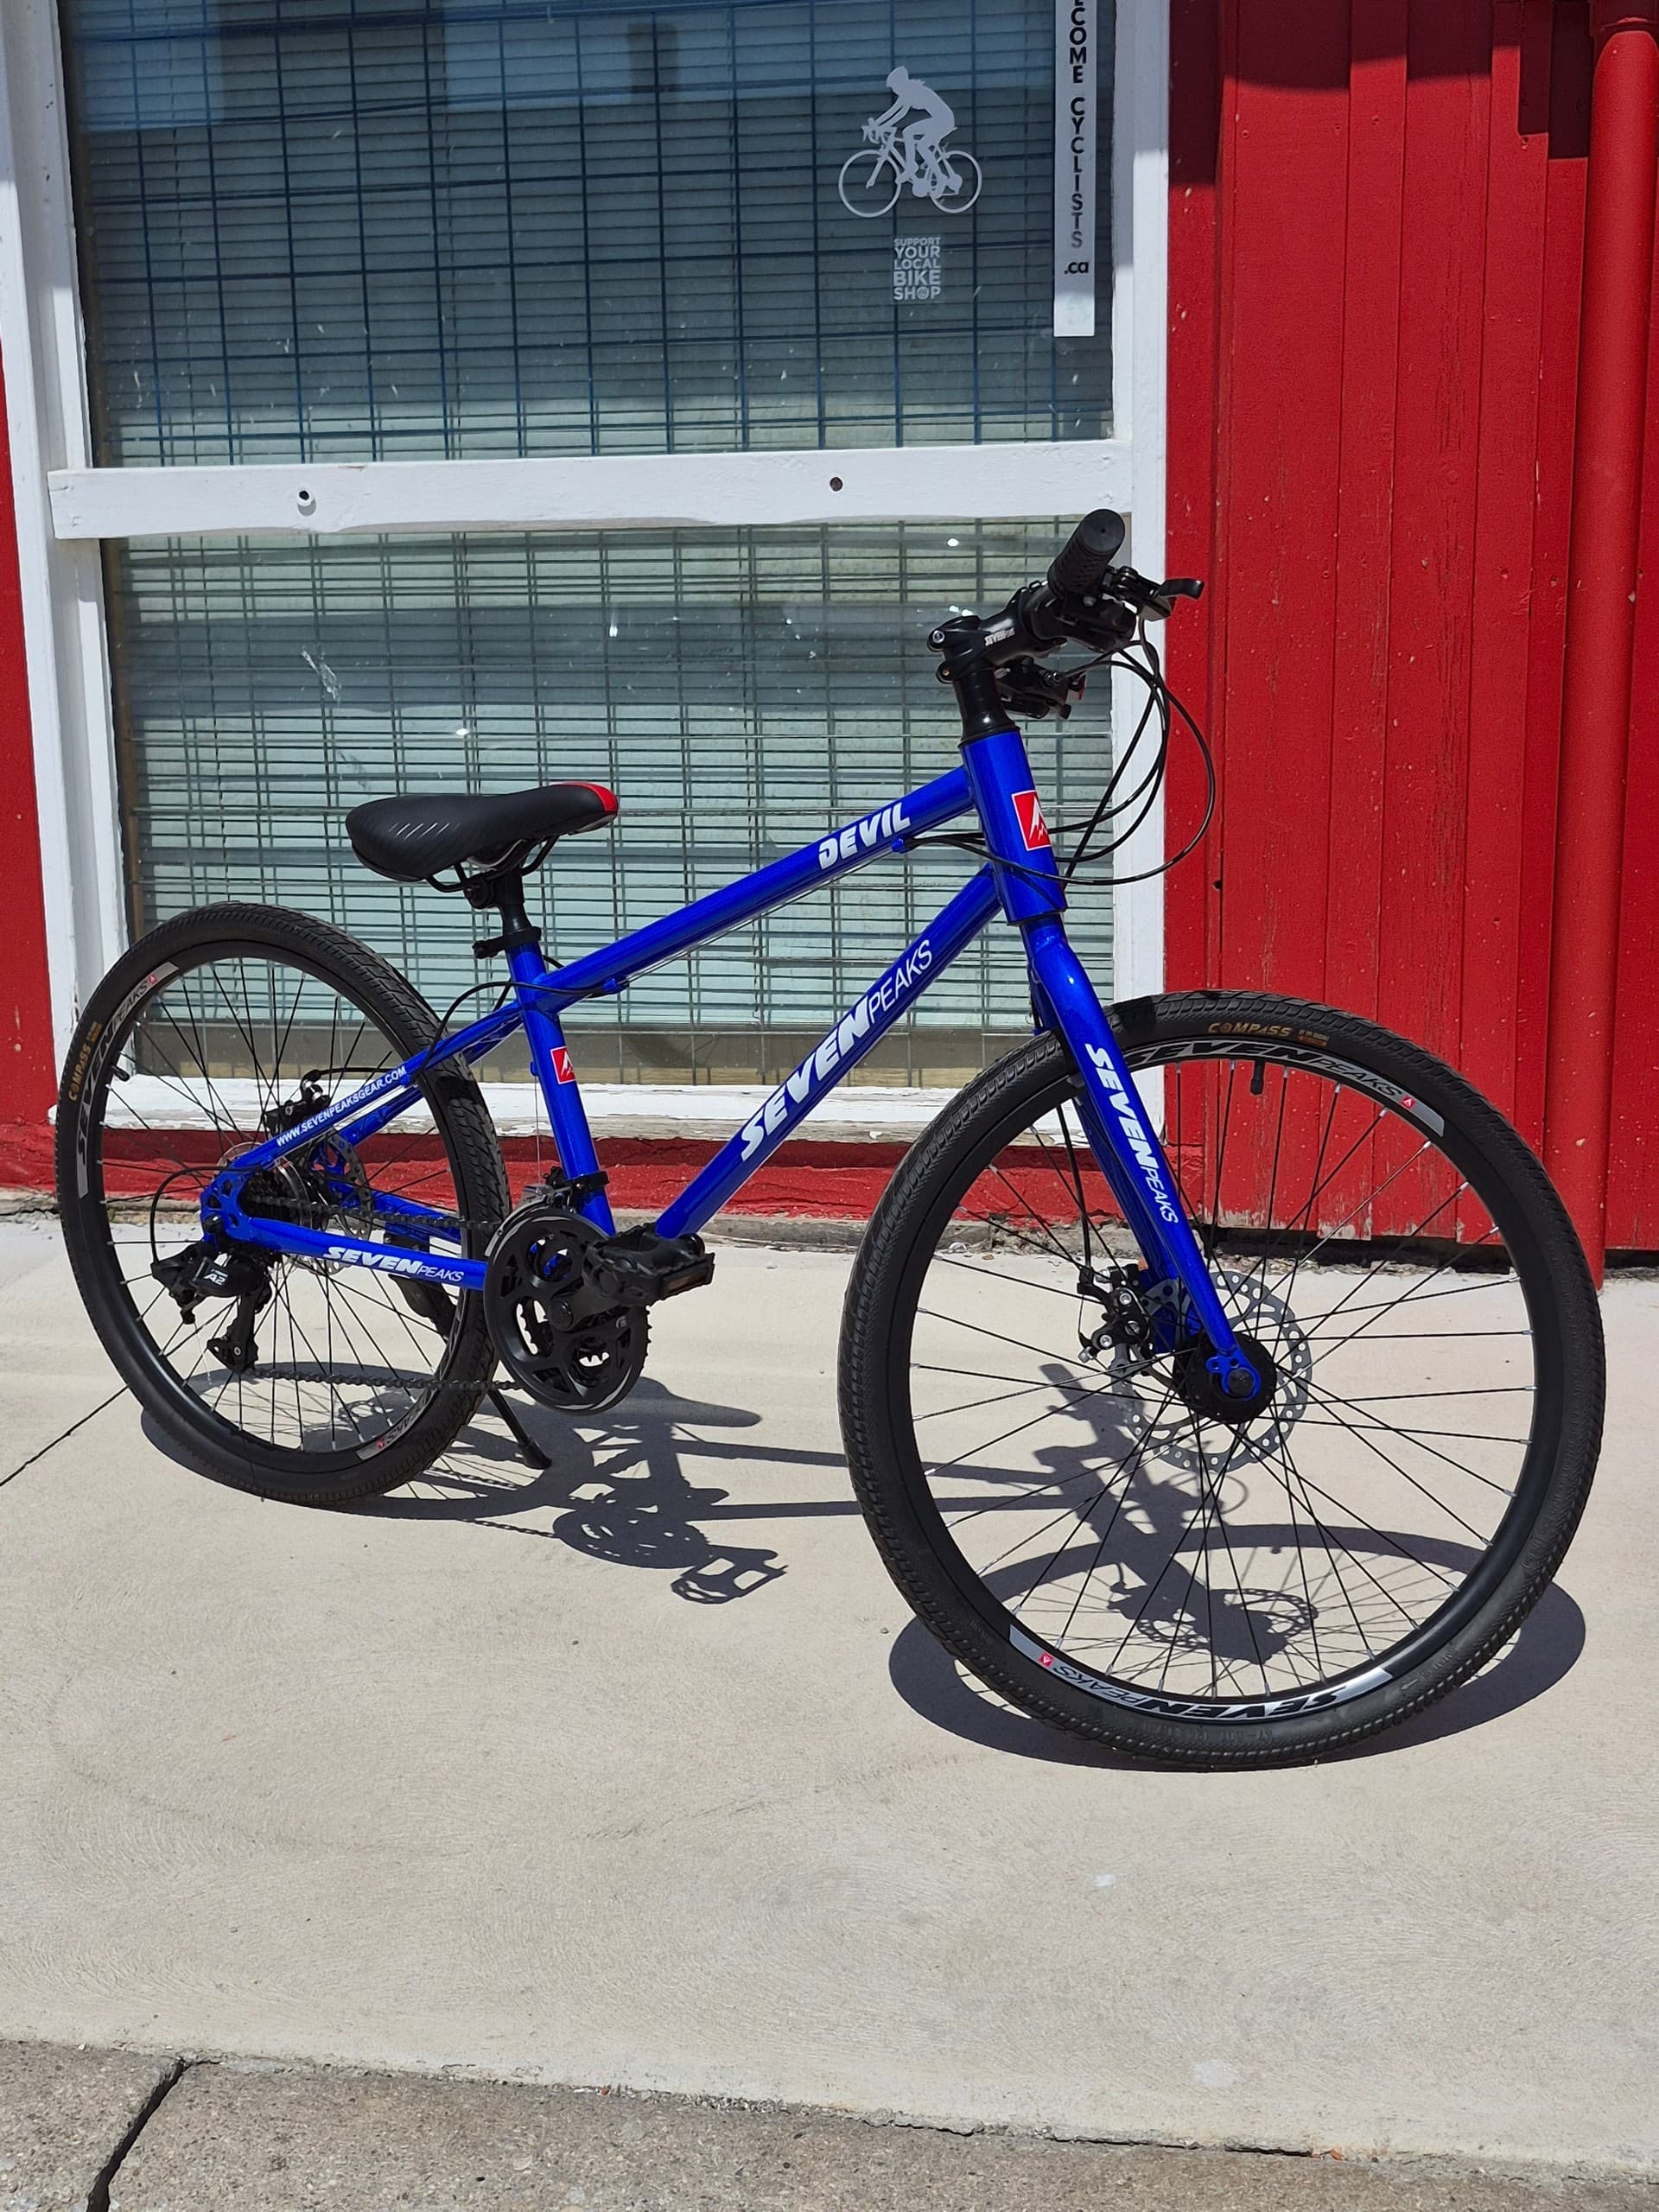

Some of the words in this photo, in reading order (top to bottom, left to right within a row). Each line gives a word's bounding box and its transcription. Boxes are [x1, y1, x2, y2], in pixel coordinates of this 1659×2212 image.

[1070, 97, 1085, 250] CYCLISTS
[893, 237, 941, 247] SUPPORT
[893, 245, 941, 259] YOUR
[893, 258, 941, 270] LOCAL
[1064, 262, 1089, 275] .ca
[893, 270, 941, 287] BIKE
[893, 286, 941, 301] SHOP
[818, 802, 911, 870] DEVIL
[1208, 1022, 1292, 1037] COMPASS
[69, 1043, 92, 1101] COMPASS
[276, 1065, 407, 1147] WWW.SEVENPEAKSGEAR.COM
